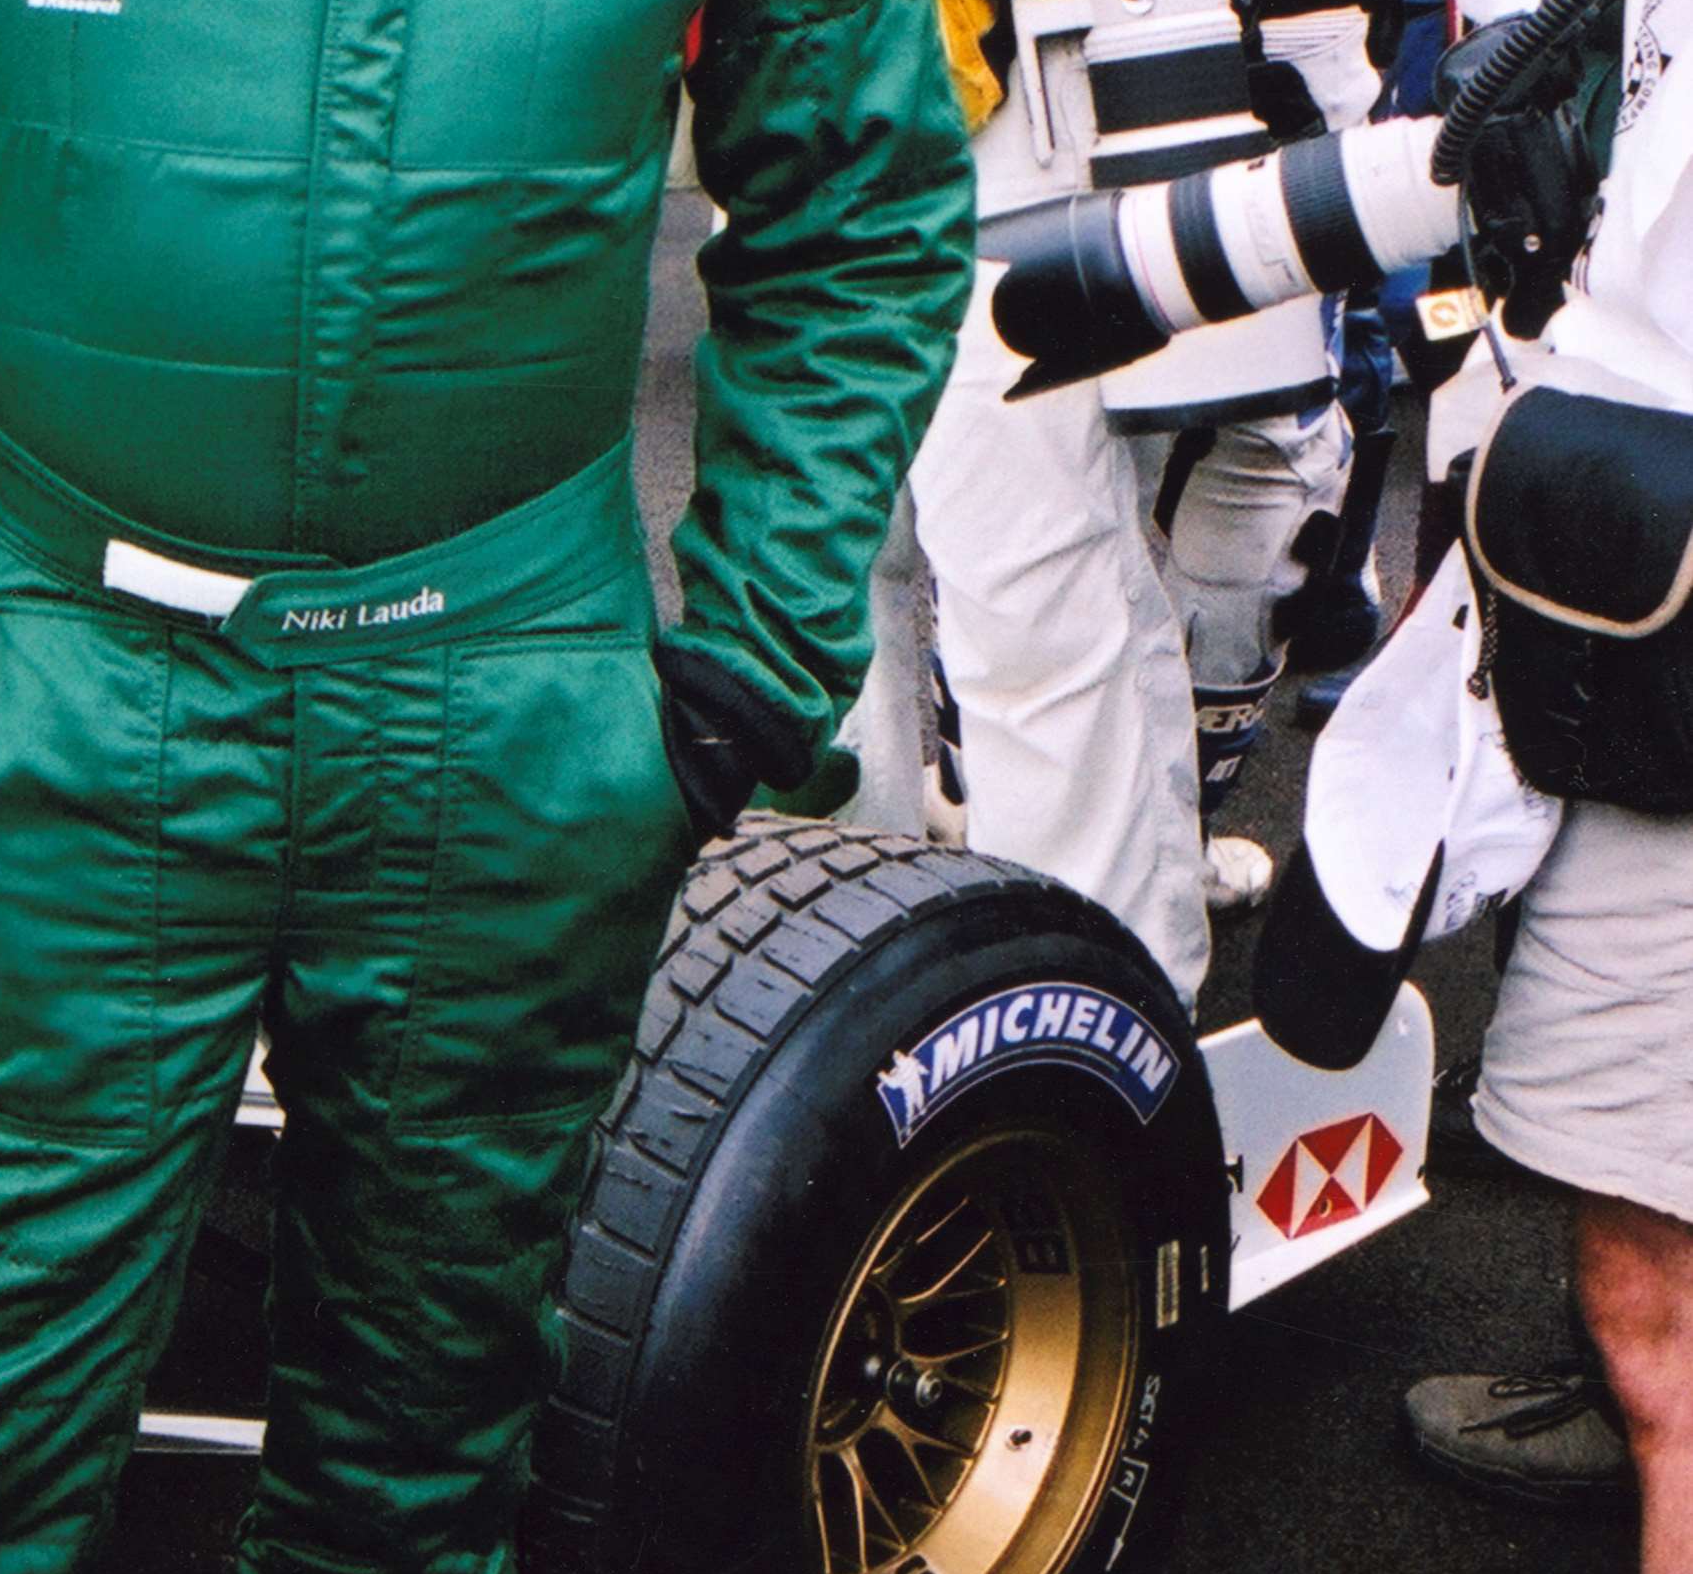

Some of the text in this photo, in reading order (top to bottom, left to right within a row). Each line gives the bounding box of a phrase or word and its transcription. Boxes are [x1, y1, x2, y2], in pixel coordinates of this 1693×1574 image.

[281, 586, 445, 632] Niki Lauda
[927, 990, 1175, 1096] MICHELIN
